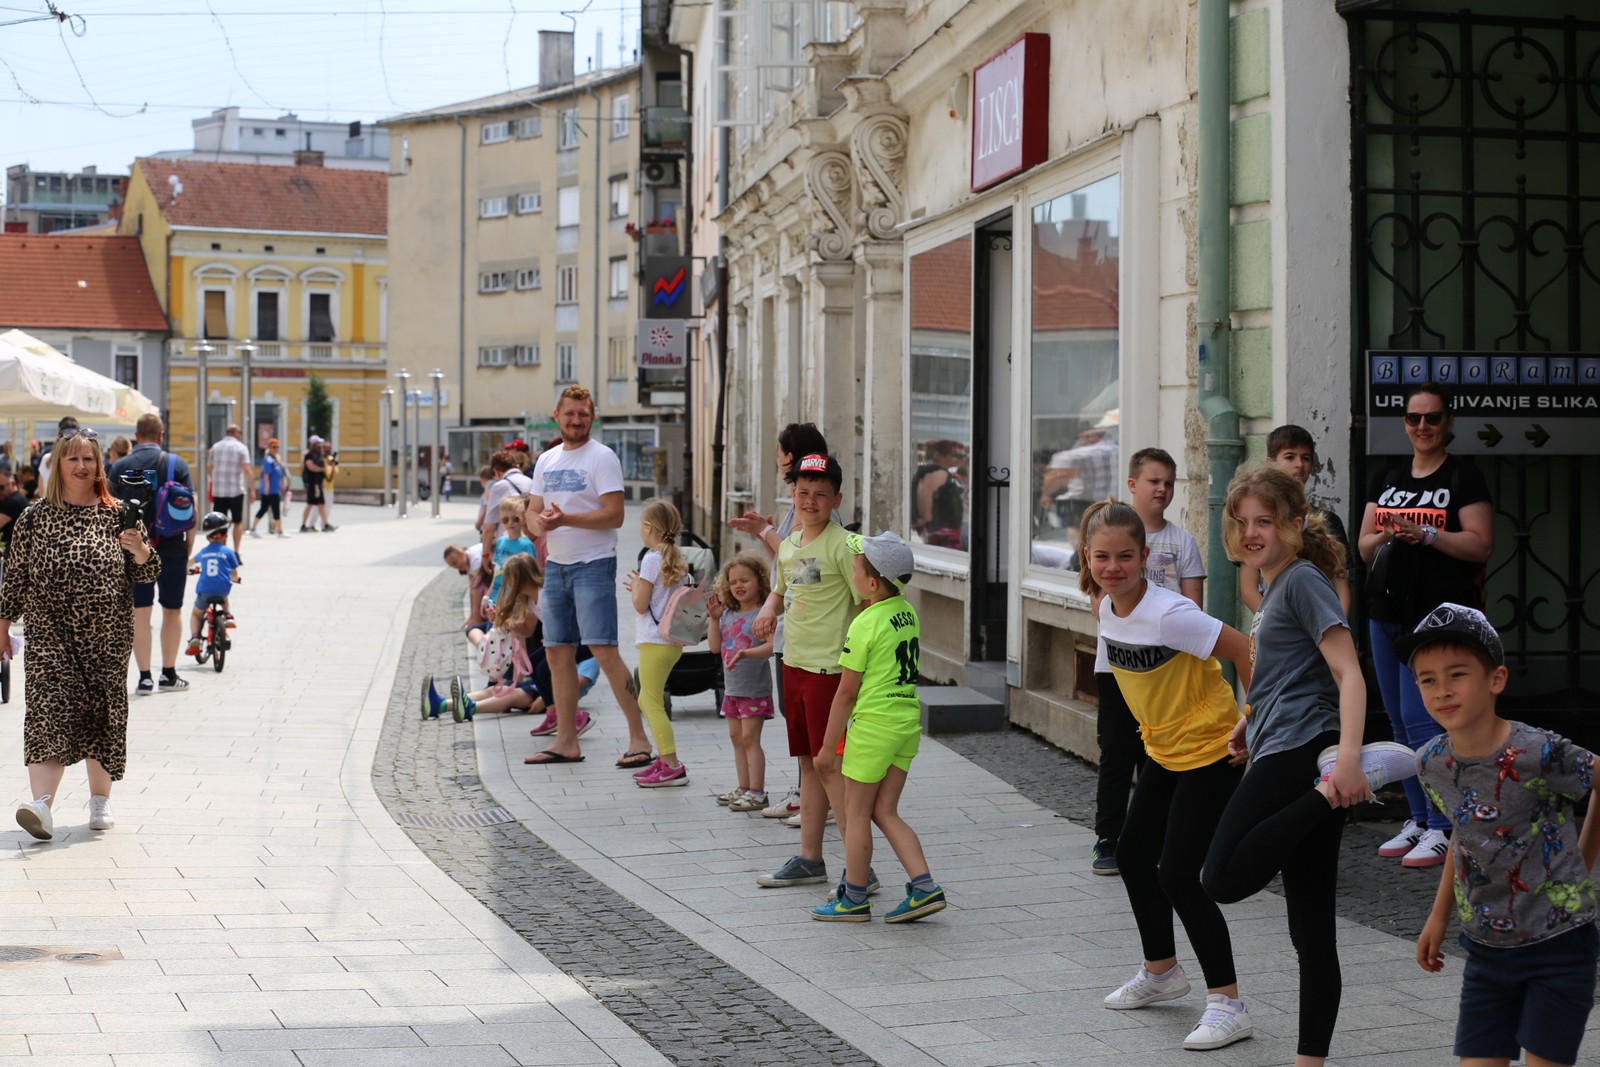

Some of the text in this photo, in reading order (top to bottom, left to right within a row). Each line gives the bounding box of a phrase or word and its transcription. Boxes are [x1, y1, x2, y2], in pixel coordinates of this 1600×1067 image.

[977, 76, 1020, 160] LISCA
[641, 352, 682, 366] Planika
[1377, 360, 1597, 382] BegoRama
[1537, 396, 1598, 408] SLIKA
[800, 457, 827, 469] MARVEL
[206, 558, 219, 577] 6
[889, 611, 916, 632] MESSI
